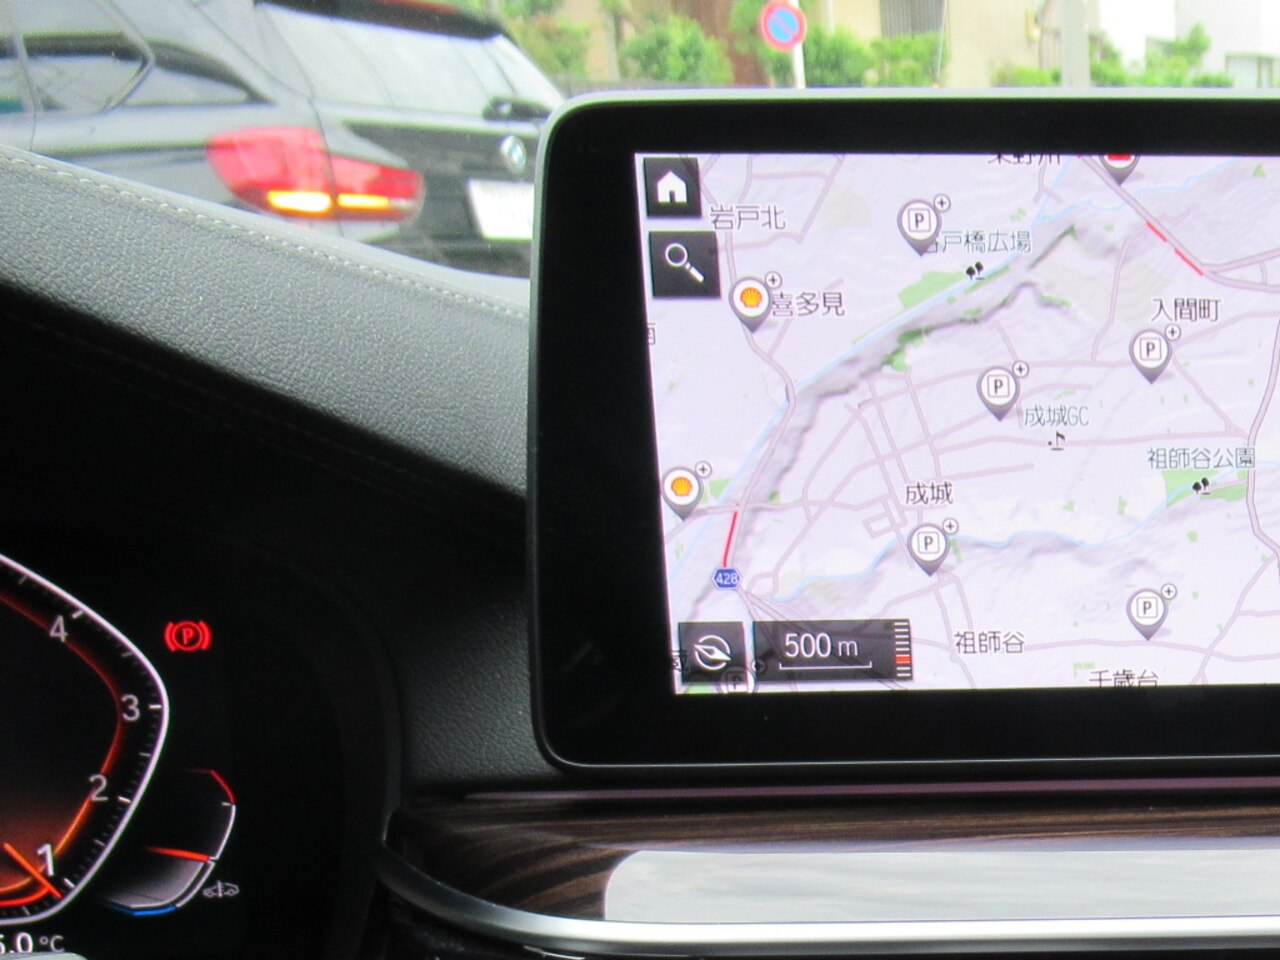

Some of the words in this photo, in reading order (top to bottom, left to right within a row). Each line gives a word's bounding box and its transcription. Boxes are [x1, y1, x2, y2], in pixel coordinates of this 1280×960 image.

[710, 205, 786, 231] 岩戸北
[771, 292, 845, 317] 喜多見
[1151, 299, 1221, 322] 入間町
[1024, 406, 1089, 427] 成城GC
[1147, 447, 1256, 470] 祖師谷公園
[905, 482, 953, 505] 成城
[715, 572, 739, 586] 428
[49, 615, 68, 643] 4
[784, 634, 831, 658] 500
[838, 639, 858, 656] m
[954, 631, 1025, 654] 祖師谷
[121, 694, 140, 722] 3
[89, 774, 109, 801] 2
[37, 843, 55, 877] 1
